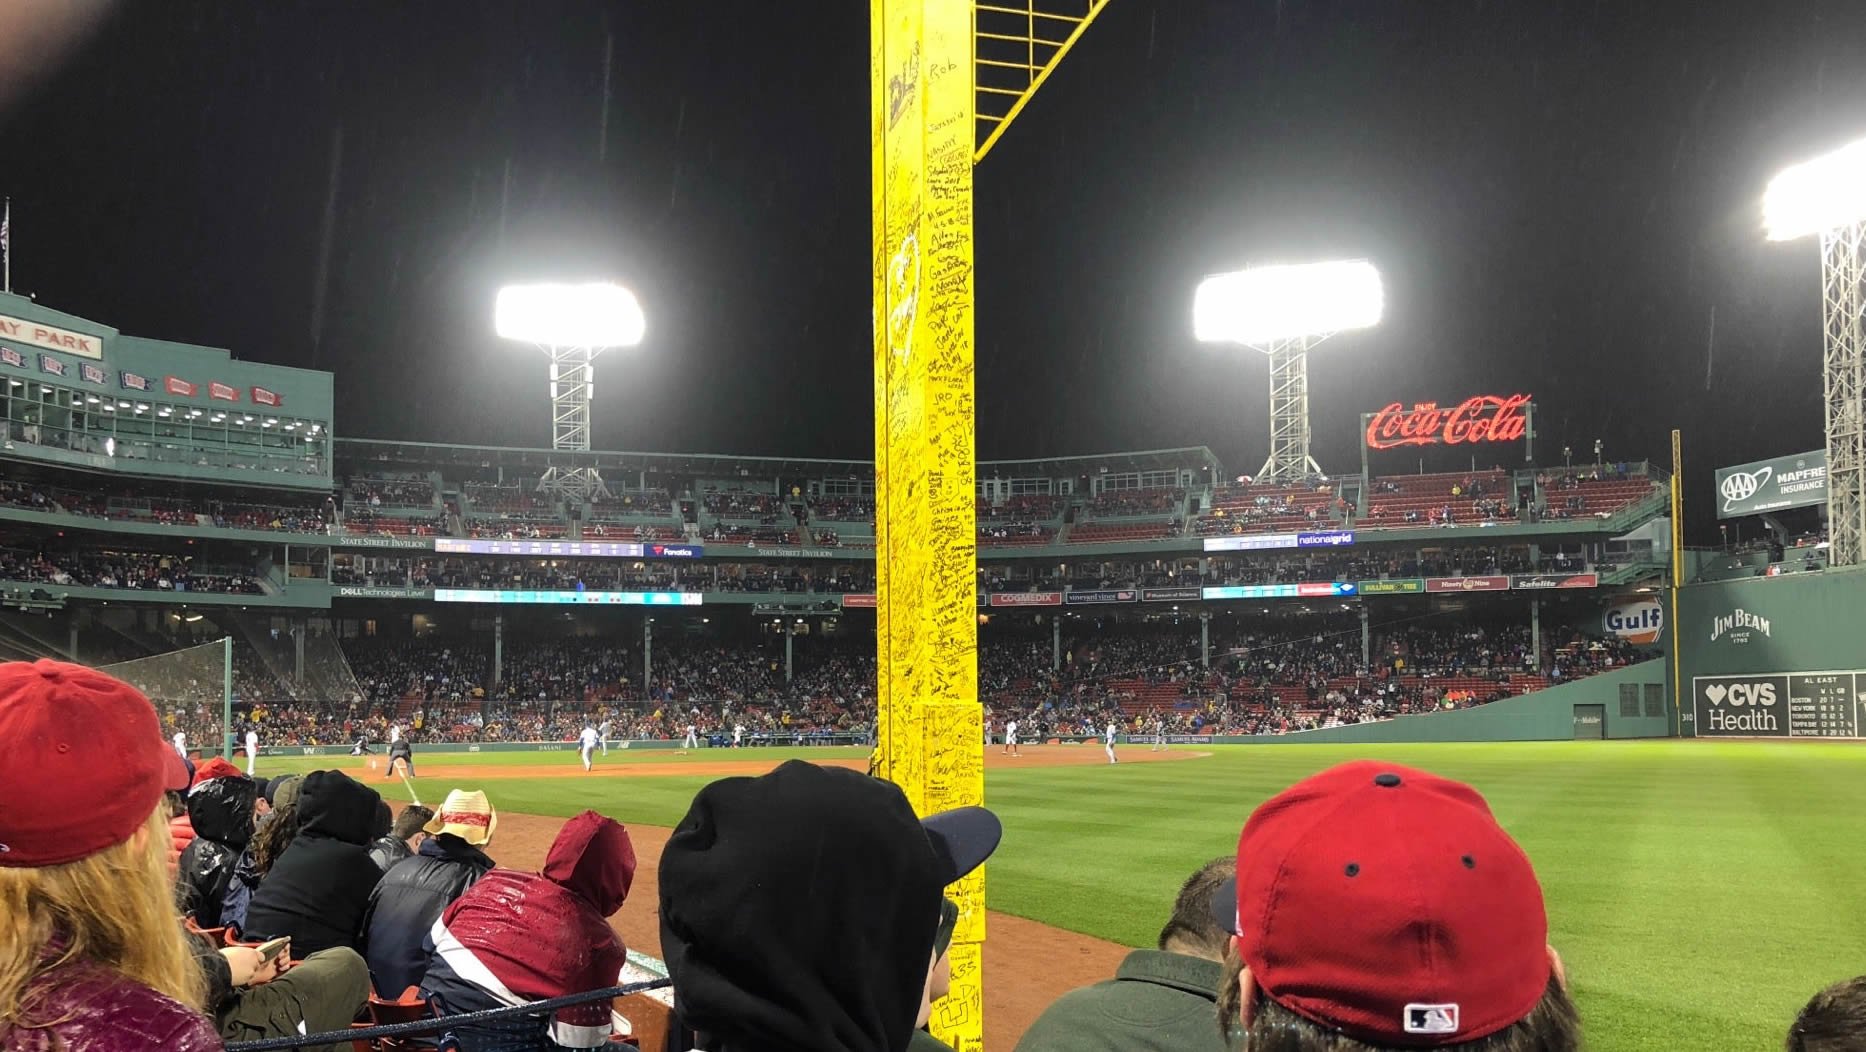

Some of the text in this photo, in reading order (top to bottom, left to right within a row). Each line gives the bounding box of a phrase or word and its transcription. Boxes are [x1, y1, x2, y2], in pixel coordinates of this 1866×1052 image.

[930, 57, 957, 79] Rob
[34, 328, 91, 352] PARK
[1415, 403, 1436, 412] ENJOY
[1366, 394, 1532, 449] Coca-Cola
[1777, 466, 1826, 483] MAPFRE
[1726, 473, 1752, 500] AAA
[1780, 480, 1825, 495] INSURANCE
[340, 537, 361, 545] STATE
[363, 538, 389, 547] STREET
[391, 539, 426, 548] PAVILION
[1299, 533, 1352, 545] nationalgrid
[663, 548, 692, 556] Fanatics
[778, 549, 801, 557] STREET
[802, 549, 833, 557] PAVILION
[1518, 580, 1557, 588] Safelite
[341, 587, 362, 596] DELL
[362, 588, 406, 598] Technologies
[407, 589, 426, 597] Level
[1607, 608, 1661, 631] Gulf
[1711, 608, 1771, 641] JIM BEAM
[1728, 683, 1777, 706] CVS
[1682, 713, 1693, 722] 310
[1708, 708, 1779, 731] Health
